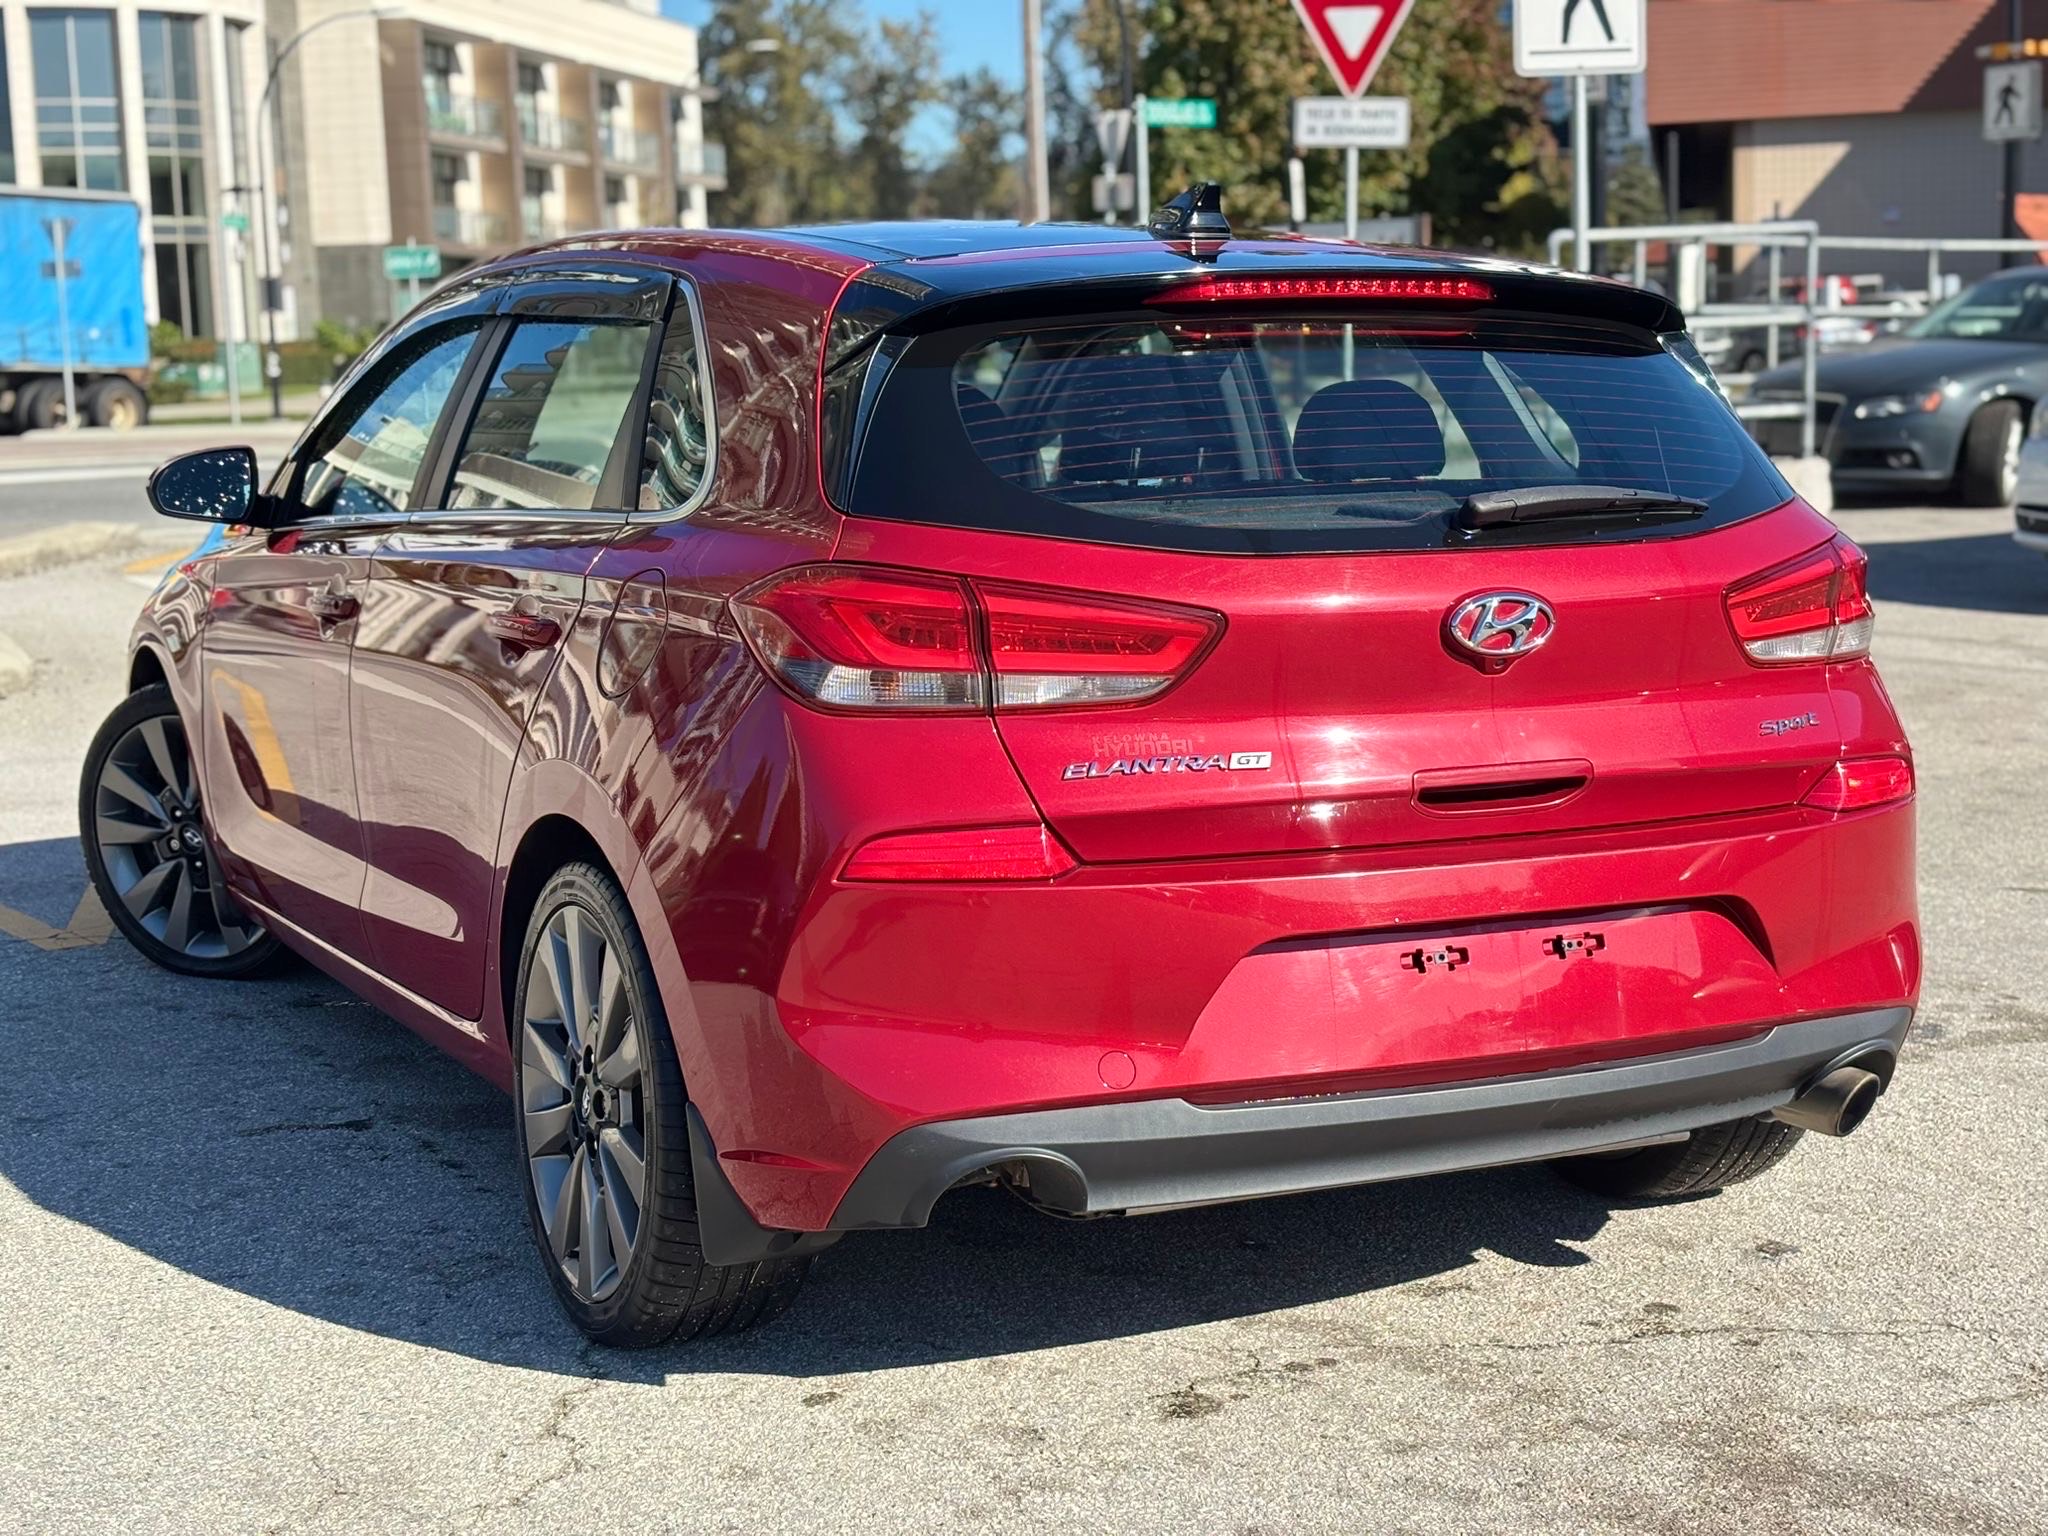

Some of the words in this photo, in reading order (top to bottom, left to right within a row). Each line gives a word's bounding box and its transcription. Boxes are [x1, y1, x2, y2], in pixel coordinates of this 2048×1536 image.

[1759, 711, 1820, 737] Sport
[1091, 732, 1169, 745] KELOWNA
[1093, 739, 1193, 757] HYUNDAI
[1062, 754, 1227, 780] ELANTRA
[1234, 753, 1268, 766] GT
